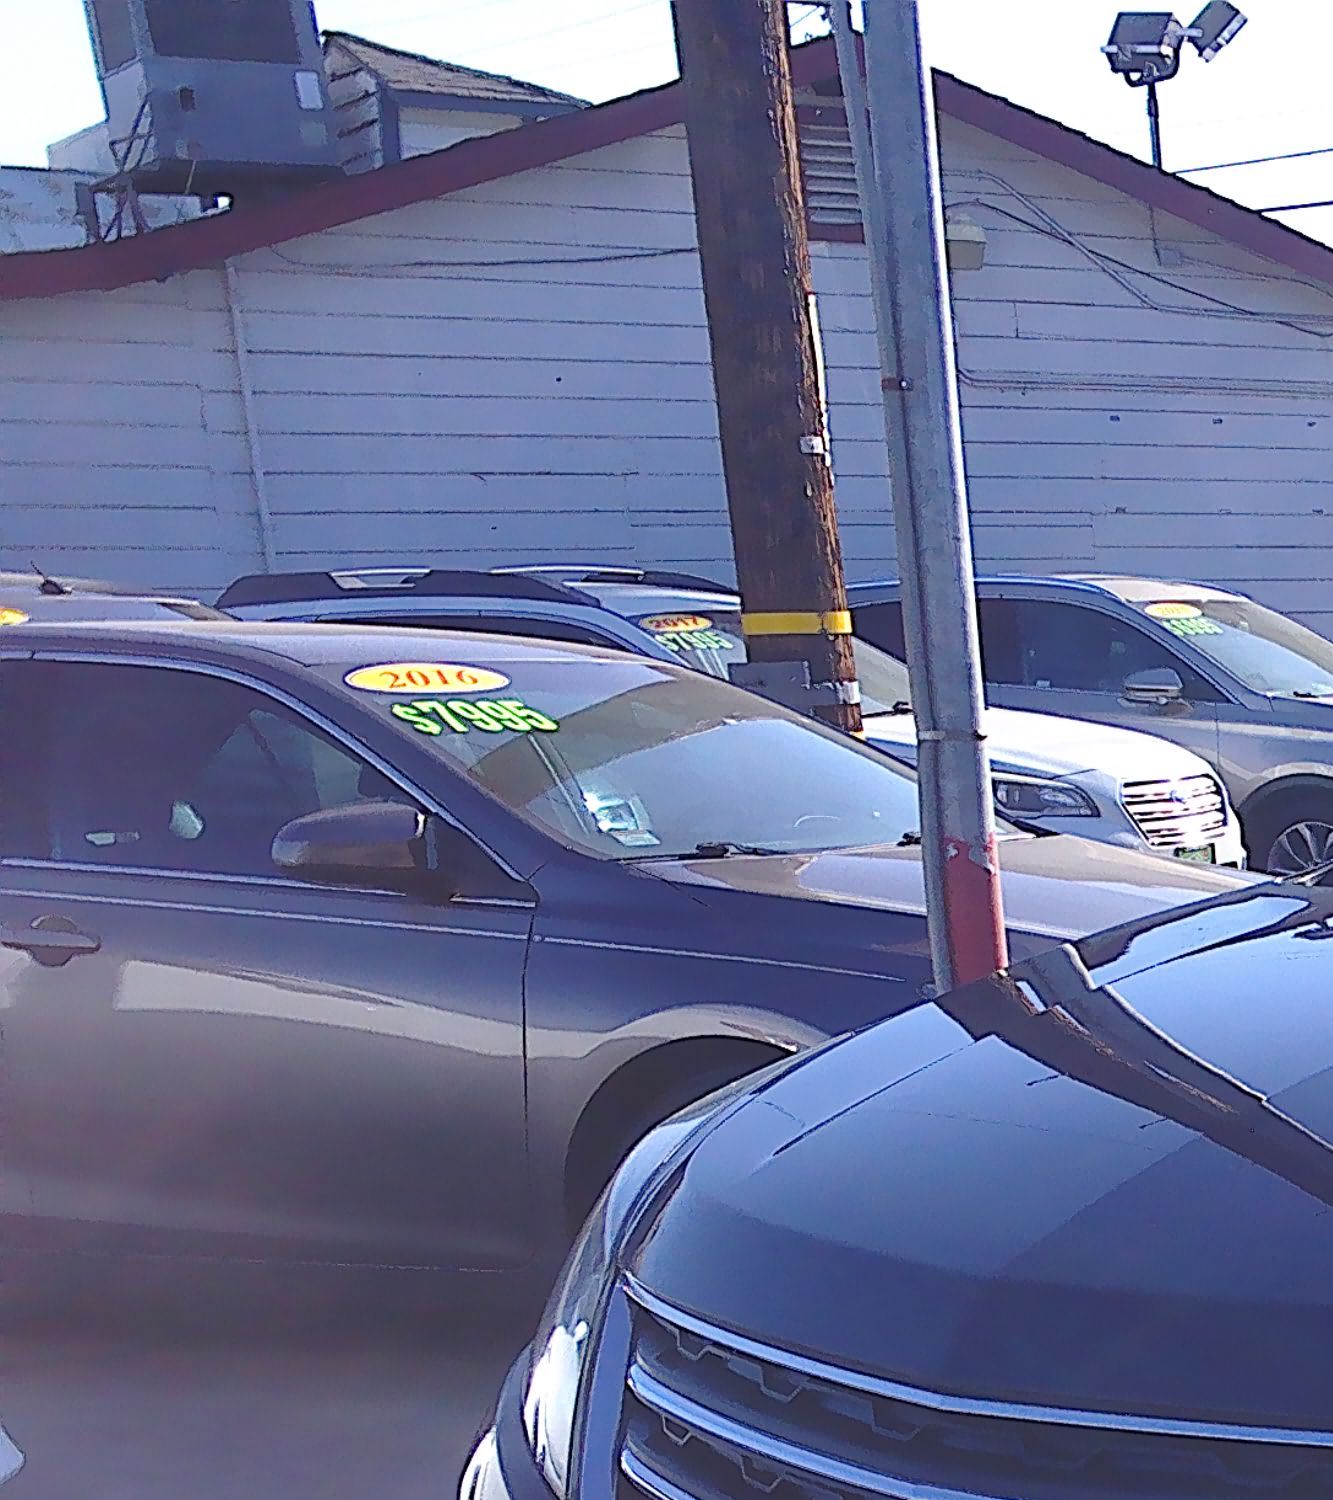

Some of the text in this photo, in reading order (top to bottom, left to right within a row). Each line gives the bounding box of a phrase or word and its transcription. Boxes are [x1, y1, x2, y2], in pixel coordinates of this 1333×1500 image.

[648, 615, 699, 629] 2017
[654, 631, 733, 652] $7995
[378, 669, 479, 689] 2016
[391, 699, 559, 736] $7995
